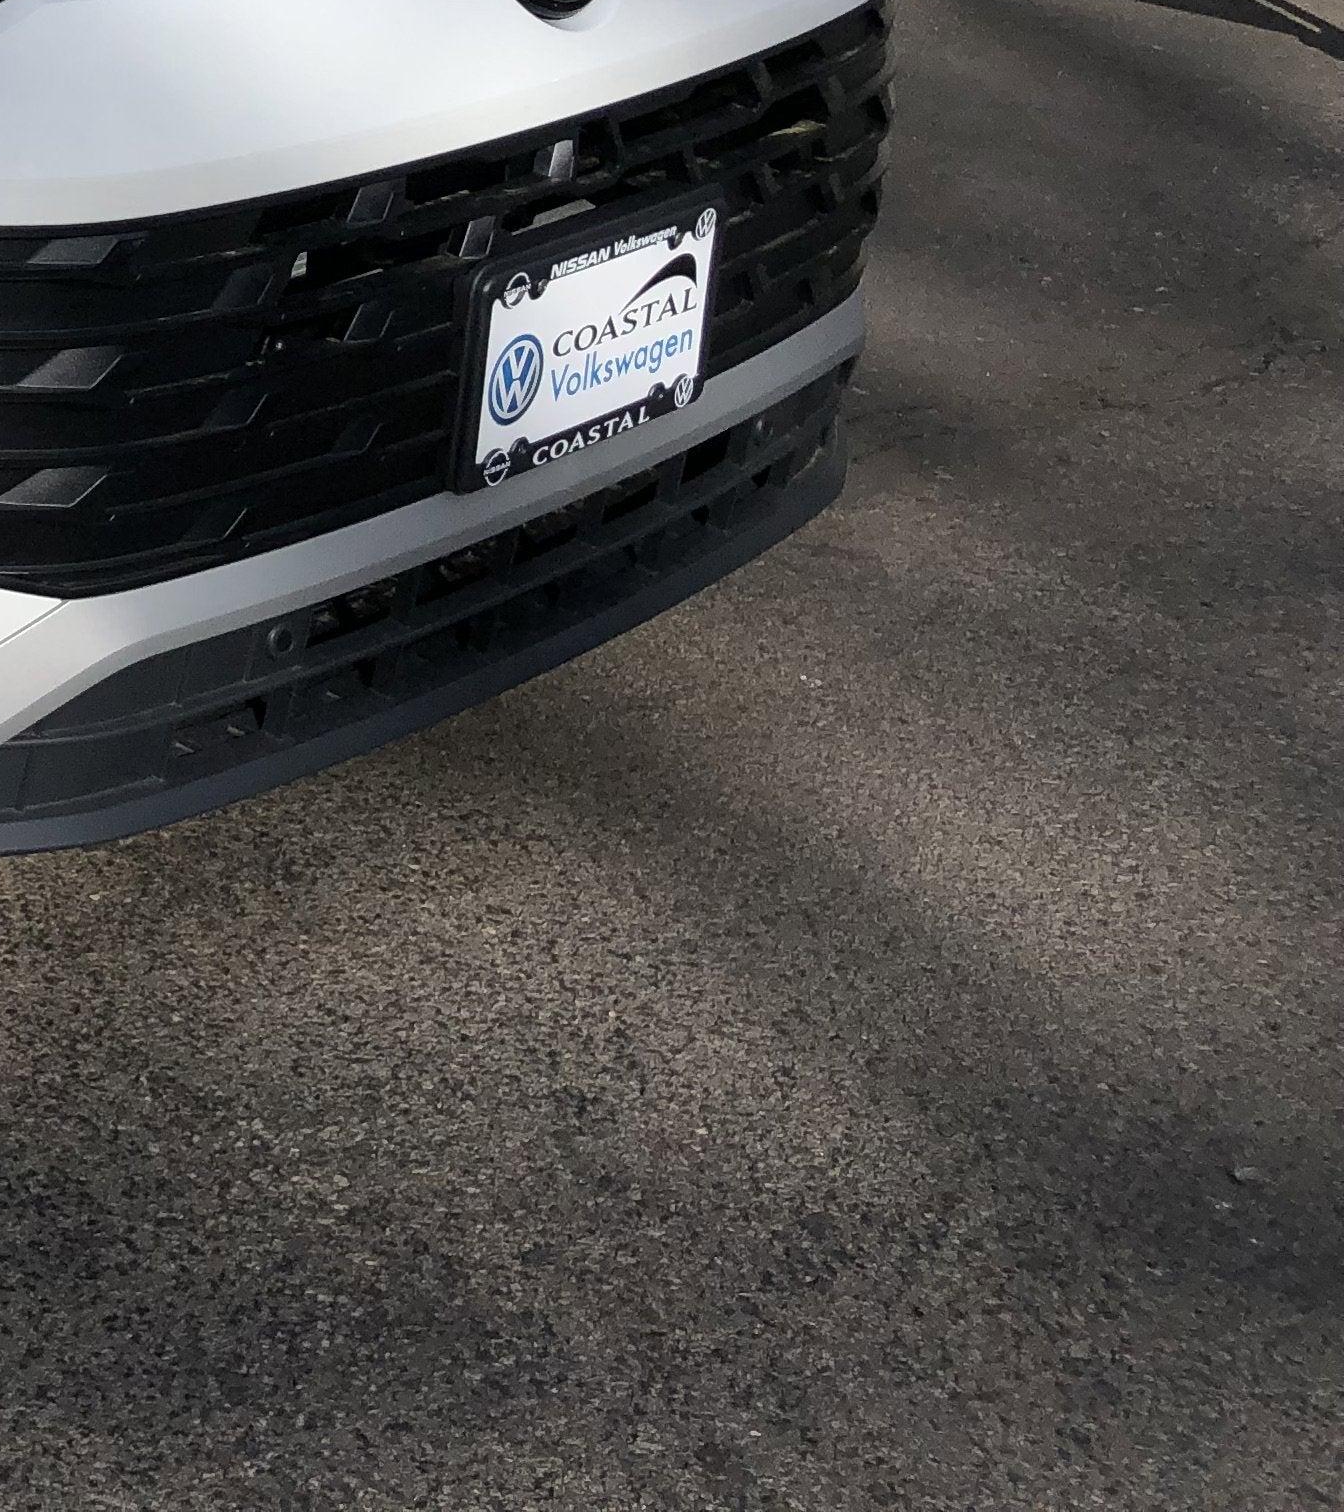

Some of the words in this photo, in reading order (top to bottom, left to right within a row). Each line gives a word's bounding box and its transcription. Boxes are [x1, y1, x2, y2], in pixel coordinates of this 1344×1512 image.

[550, 245, 611, 280] NISSAN
[614, 225, 677, 257] Volkswagen
[552, 287, 698, 357] COASTAL
[551, 328, 693, 402] Volkswagen
[532, 405, 650, 466] COASTAL
